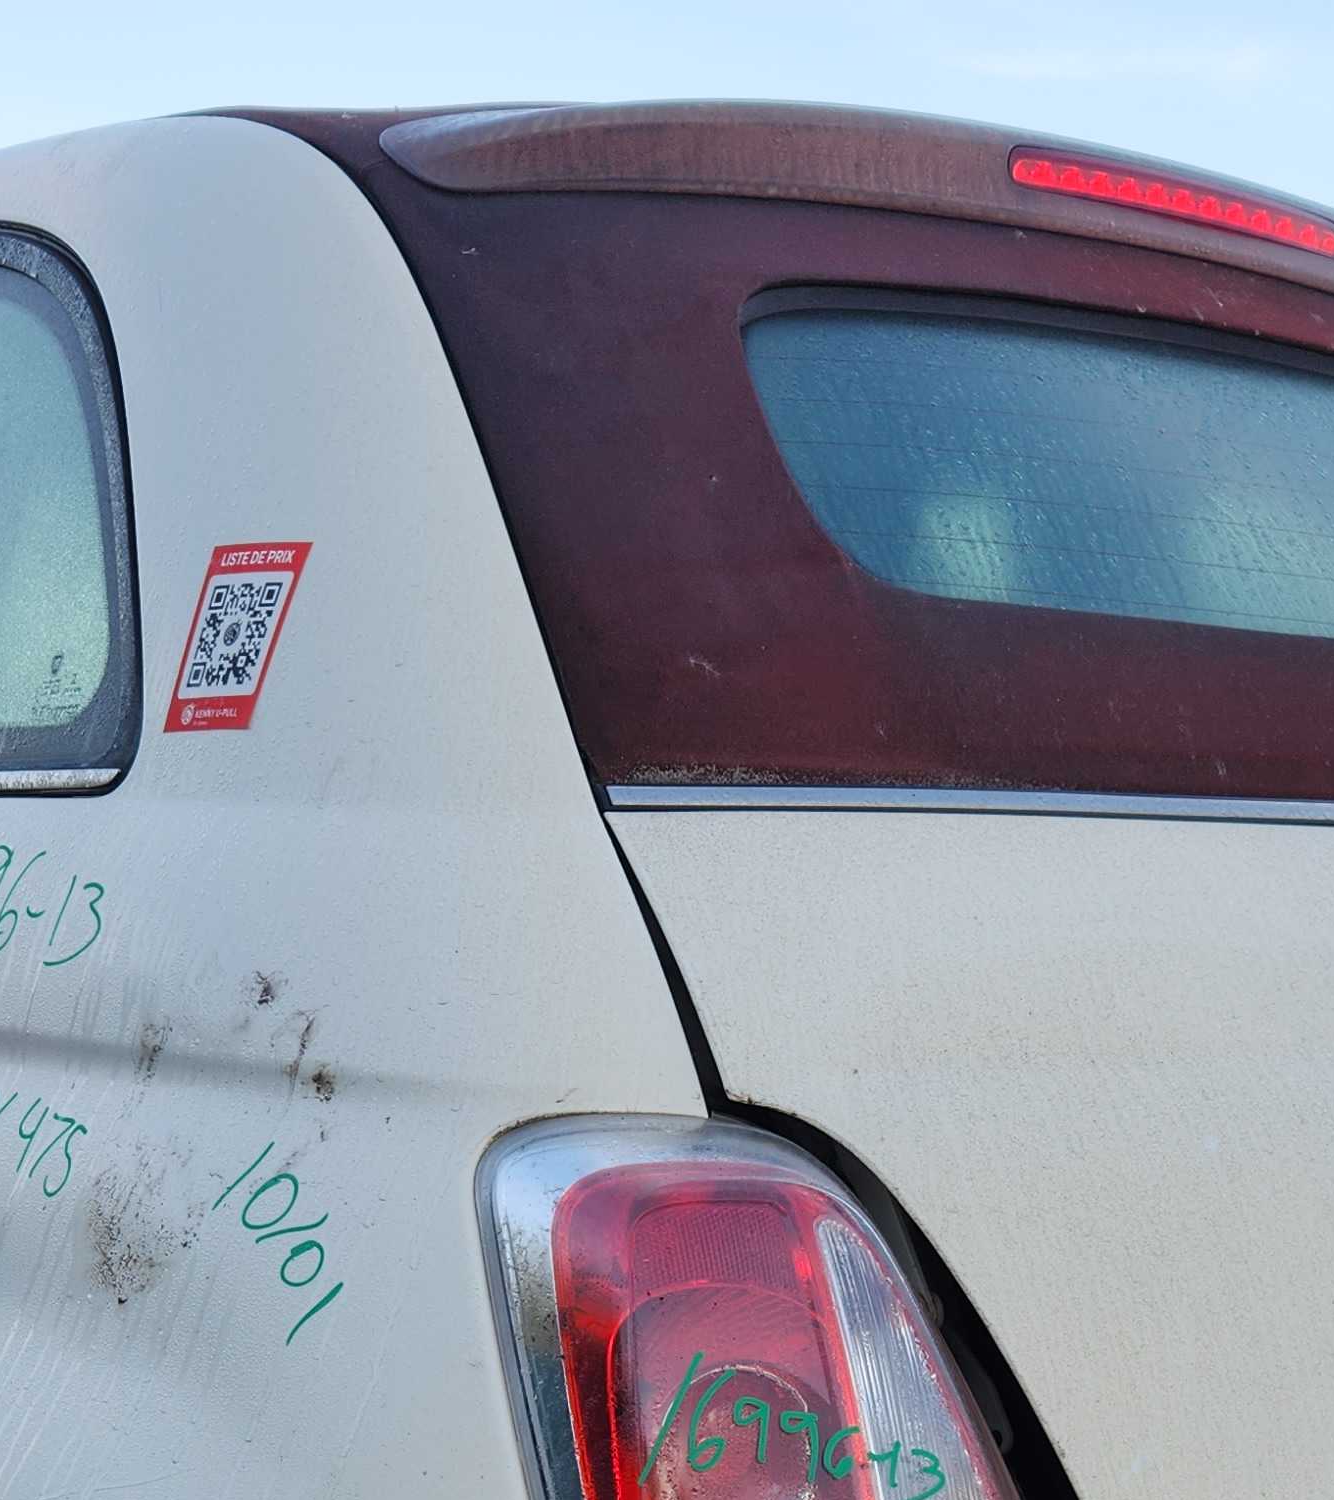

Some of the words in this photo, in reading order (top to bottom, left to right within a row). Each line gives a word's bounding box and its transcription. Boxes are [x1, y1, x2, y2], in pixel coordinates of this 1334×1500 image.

[220, 551, 250, 567] LISTE
[250, 551, 265, 565] DE
[266, 550, 296, 564] PRIX
